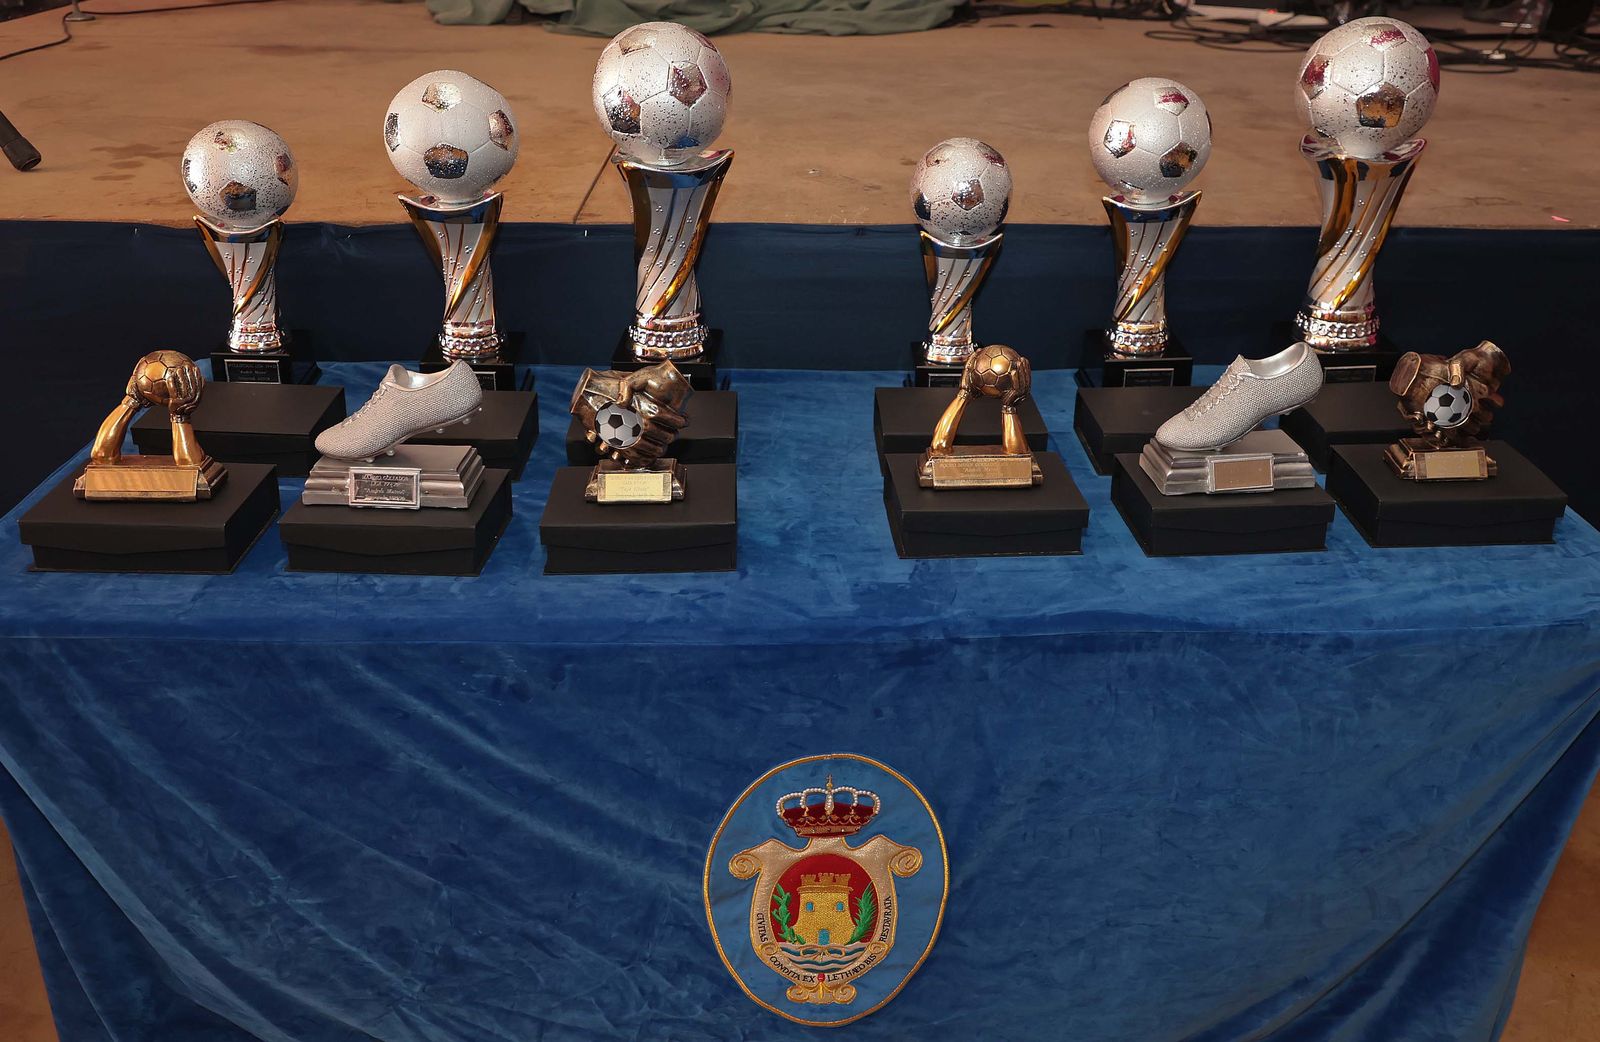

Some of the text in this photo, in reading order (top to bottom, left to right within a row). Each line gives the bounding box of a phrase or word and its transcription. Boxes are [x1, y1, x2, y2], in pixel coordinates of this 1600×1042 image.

[757, 912, 768, 942] CIVITAS
[770, 956, 800, 980] CONDITA
[802, 975, 816, 983] EX
[864, 953, 877, 965] BIS
